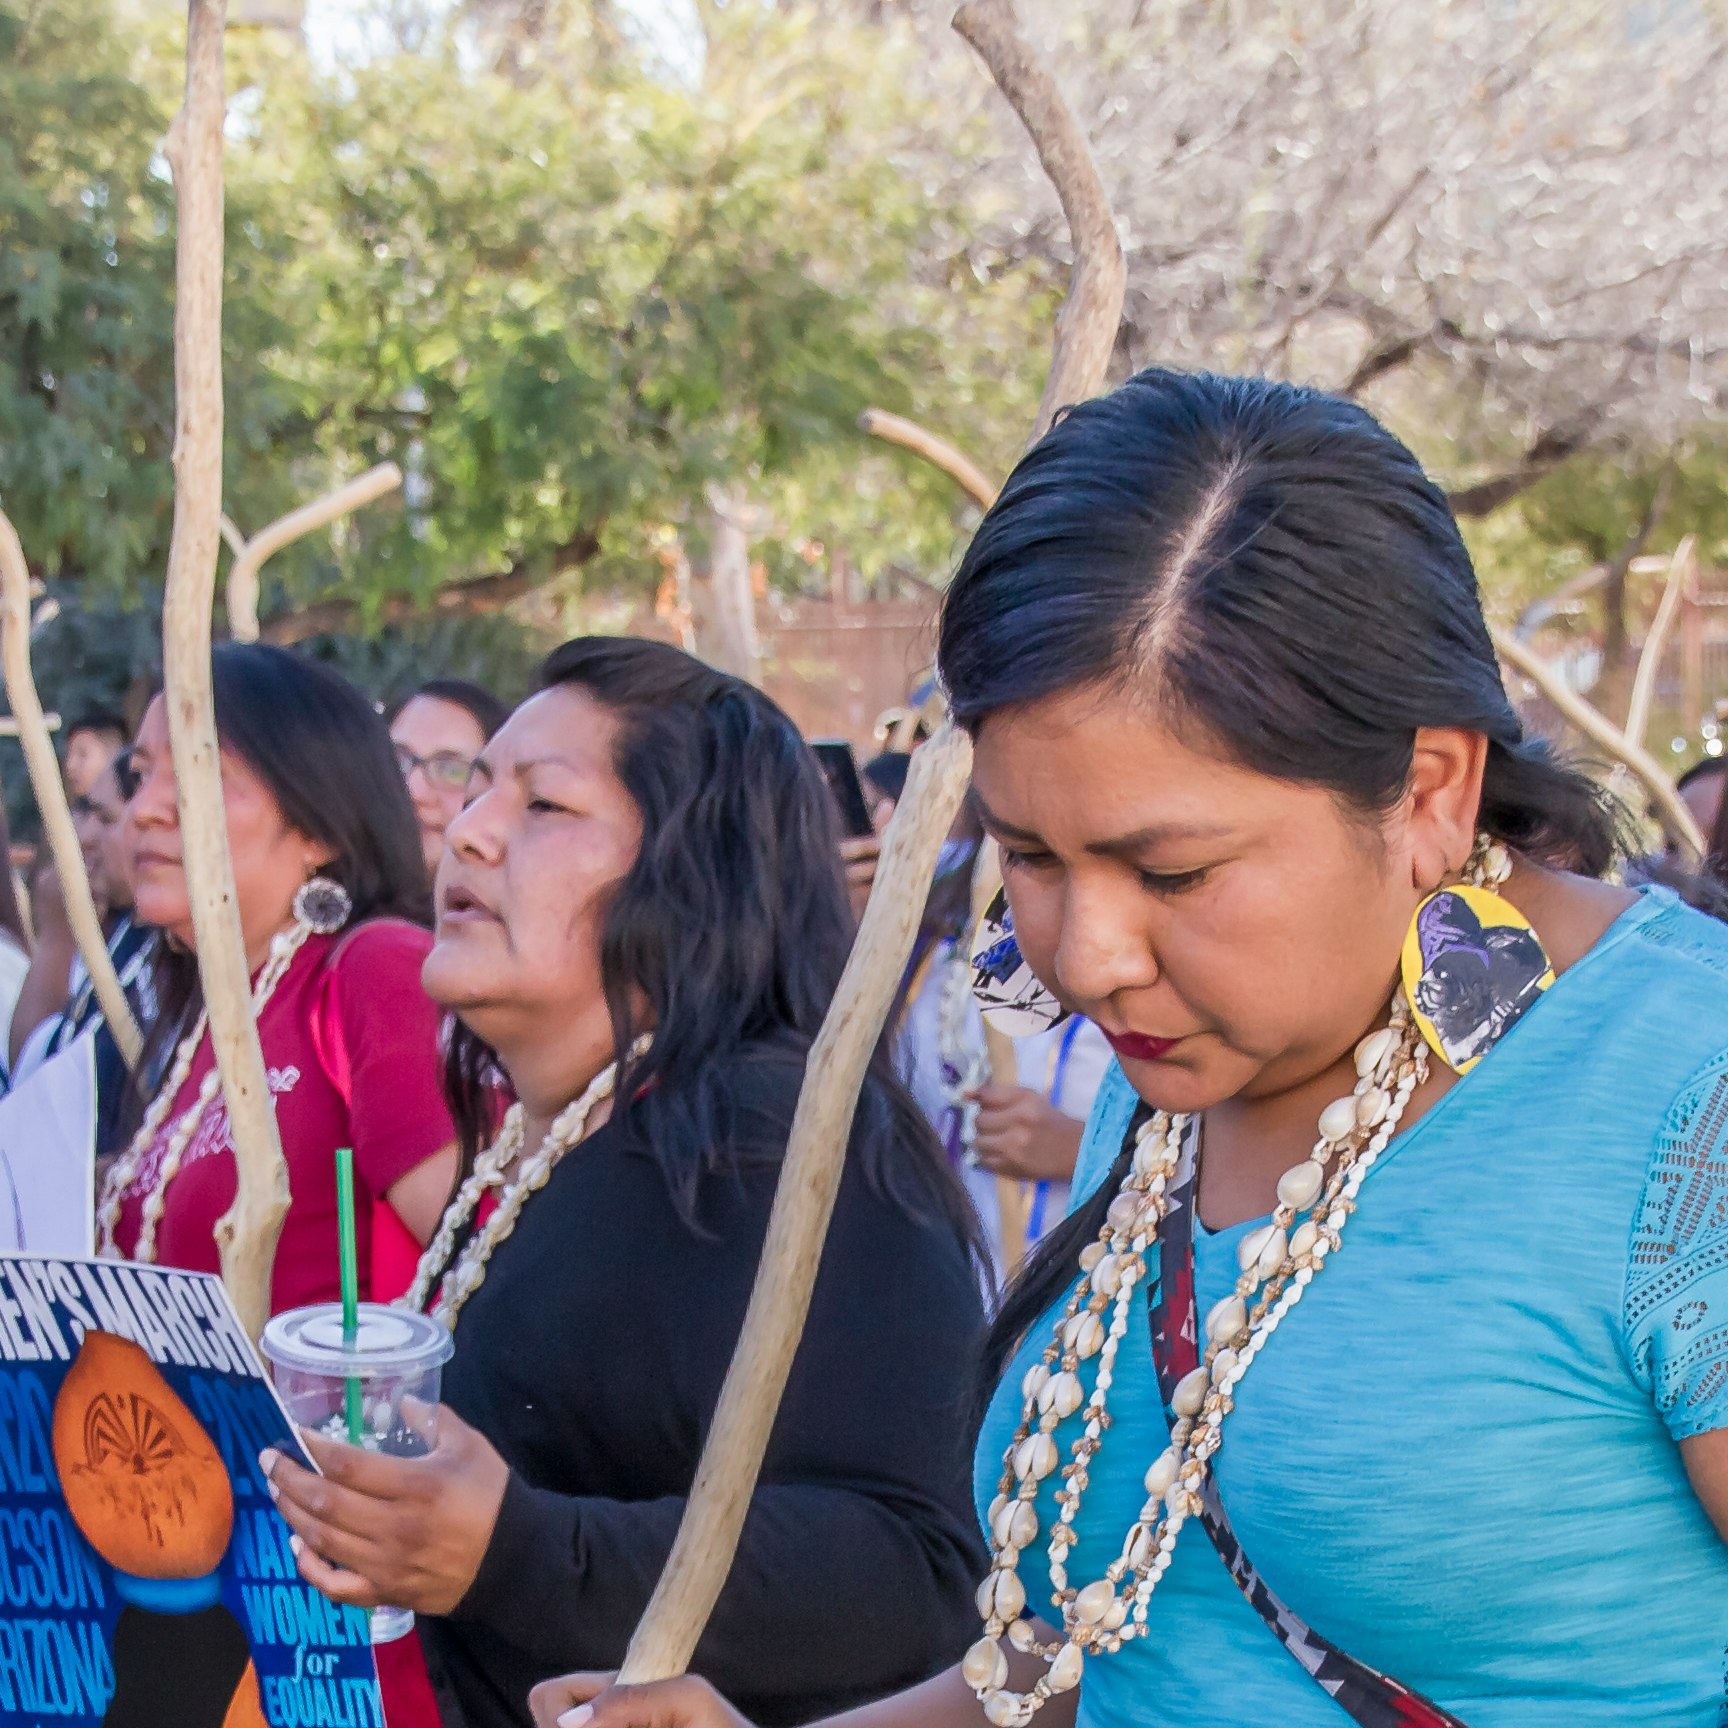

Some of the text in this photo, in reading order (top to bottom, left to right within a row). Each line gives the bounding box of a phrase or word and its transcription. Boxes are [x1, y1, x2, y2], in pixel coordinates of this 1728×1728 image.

[86, 1263, 263, 1377] MARCH
[241, 1583, 372, 1646] WOMEN
[293, 1643, 339, 1684] for
